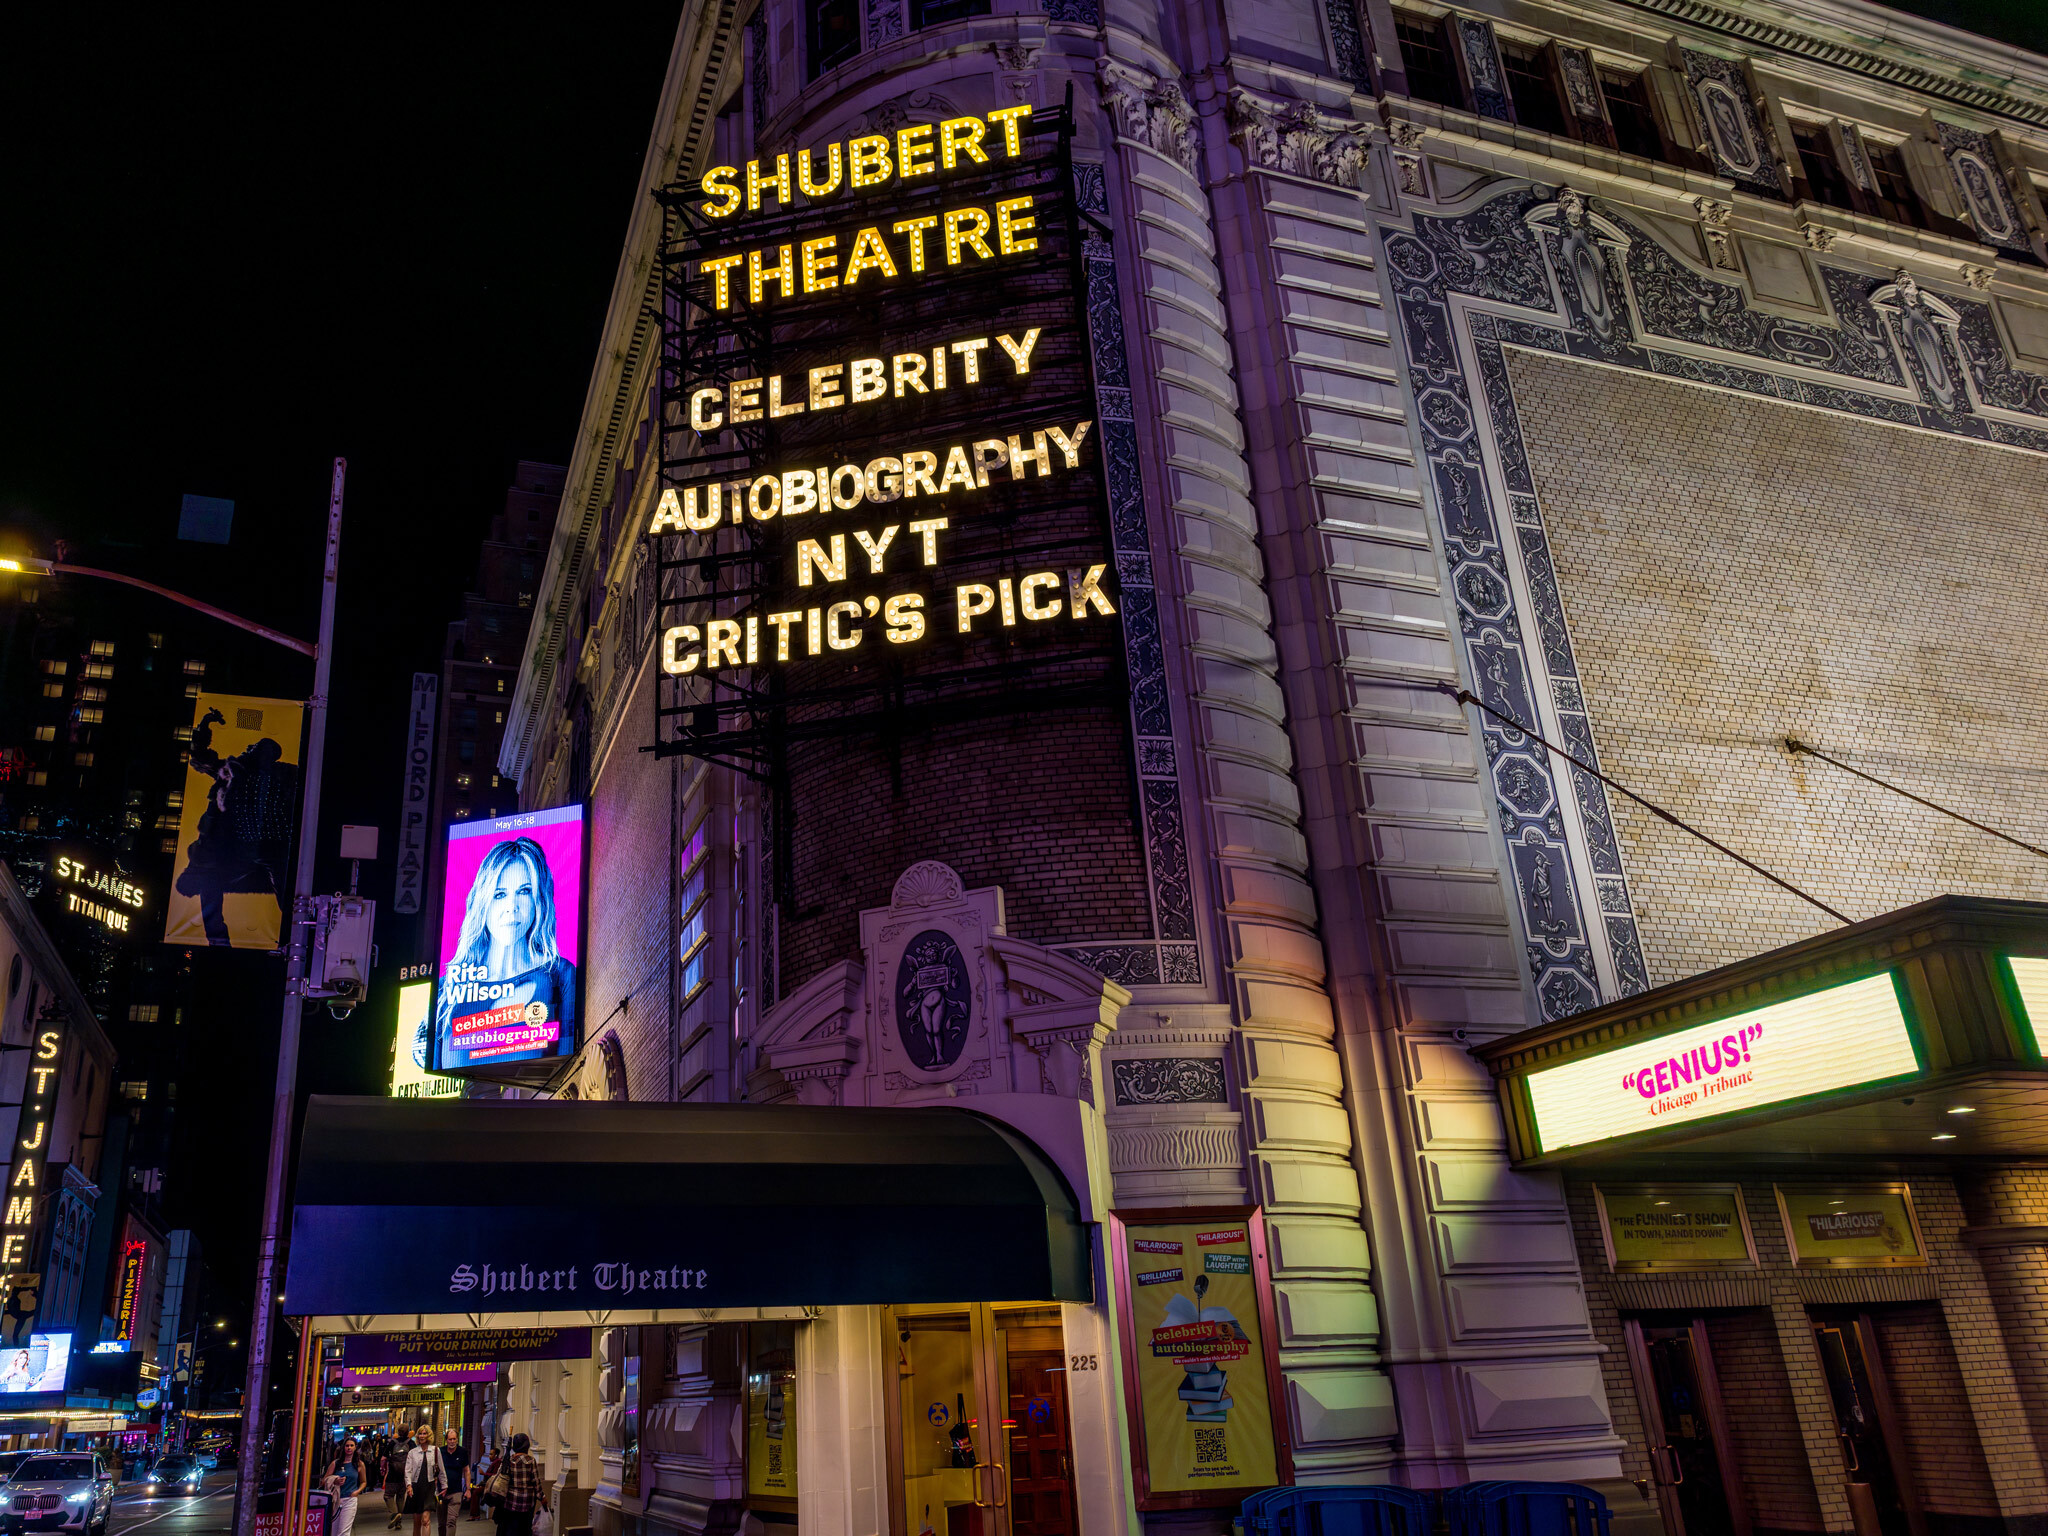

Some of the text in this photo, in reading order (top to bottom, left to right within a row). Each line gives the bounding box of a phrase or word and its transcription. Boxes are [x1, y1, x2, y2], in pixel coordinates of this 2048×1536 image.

[700, 104, 1033, 219] SHUBERT
[700, 195, 1039, 310] THEATRE
[690, 327, 1042, 432] CELEBRITY
[649, 420, 1092, 536] AUTOBIOGRAPHY
[797, 517, 949, 587] NYT
[662, 564, 1116, 676] CRITIC'S PICK
[397, 675, 436, 909] MILFORD PLAZA
[495, 816, 535, 830] May 16-18
[86, 870, 144, 908] JAMES
[69, 893, 129, 932] TITANIQUE
[447, 962, 489, 984] Rita
[445, 982, 515, 1005] Wilson
[455, 1007, 523, 1032] celebrity
[453, 1025, 557, 1047] autobiography
[1622, 1023, 1763, 1099] "GENIUS!"
[1701, 1070, 1753, 1098] Tribune
[1635, 1213, 1693, 1226] FUNNIEST
[1695, 1212, 1731, 1225] SHOW
[1624, 1230, 1634, 1239] IN
[1665, 1229, 1694, 1238] HANDS
[449, 1262, 708, 1298] Shubert Theatre
[117, 1259, 138, 1340] PIZZERIA
[1155, 1324, 1213, 1341] celebrity
[399, 1342, 423, 1352] PUT
[426, 1340, 459, 1351] YOUR
[461, 1339, 498, 1350] DRINK
[1156, 1341, 1246, 1355] autobiography
[389, 1364, 420, 1374] WITH
[1071, 1355, 1097, 1371] 225
[351, 1391, 362, 1404] 9
[373, 1395, 387, 1403] BEST
[389, 1394, 411, 1402] REVIVAL
[421, 1392, 445, 1401] MUSICAL
[306, 1512, 321, 1523] OF
